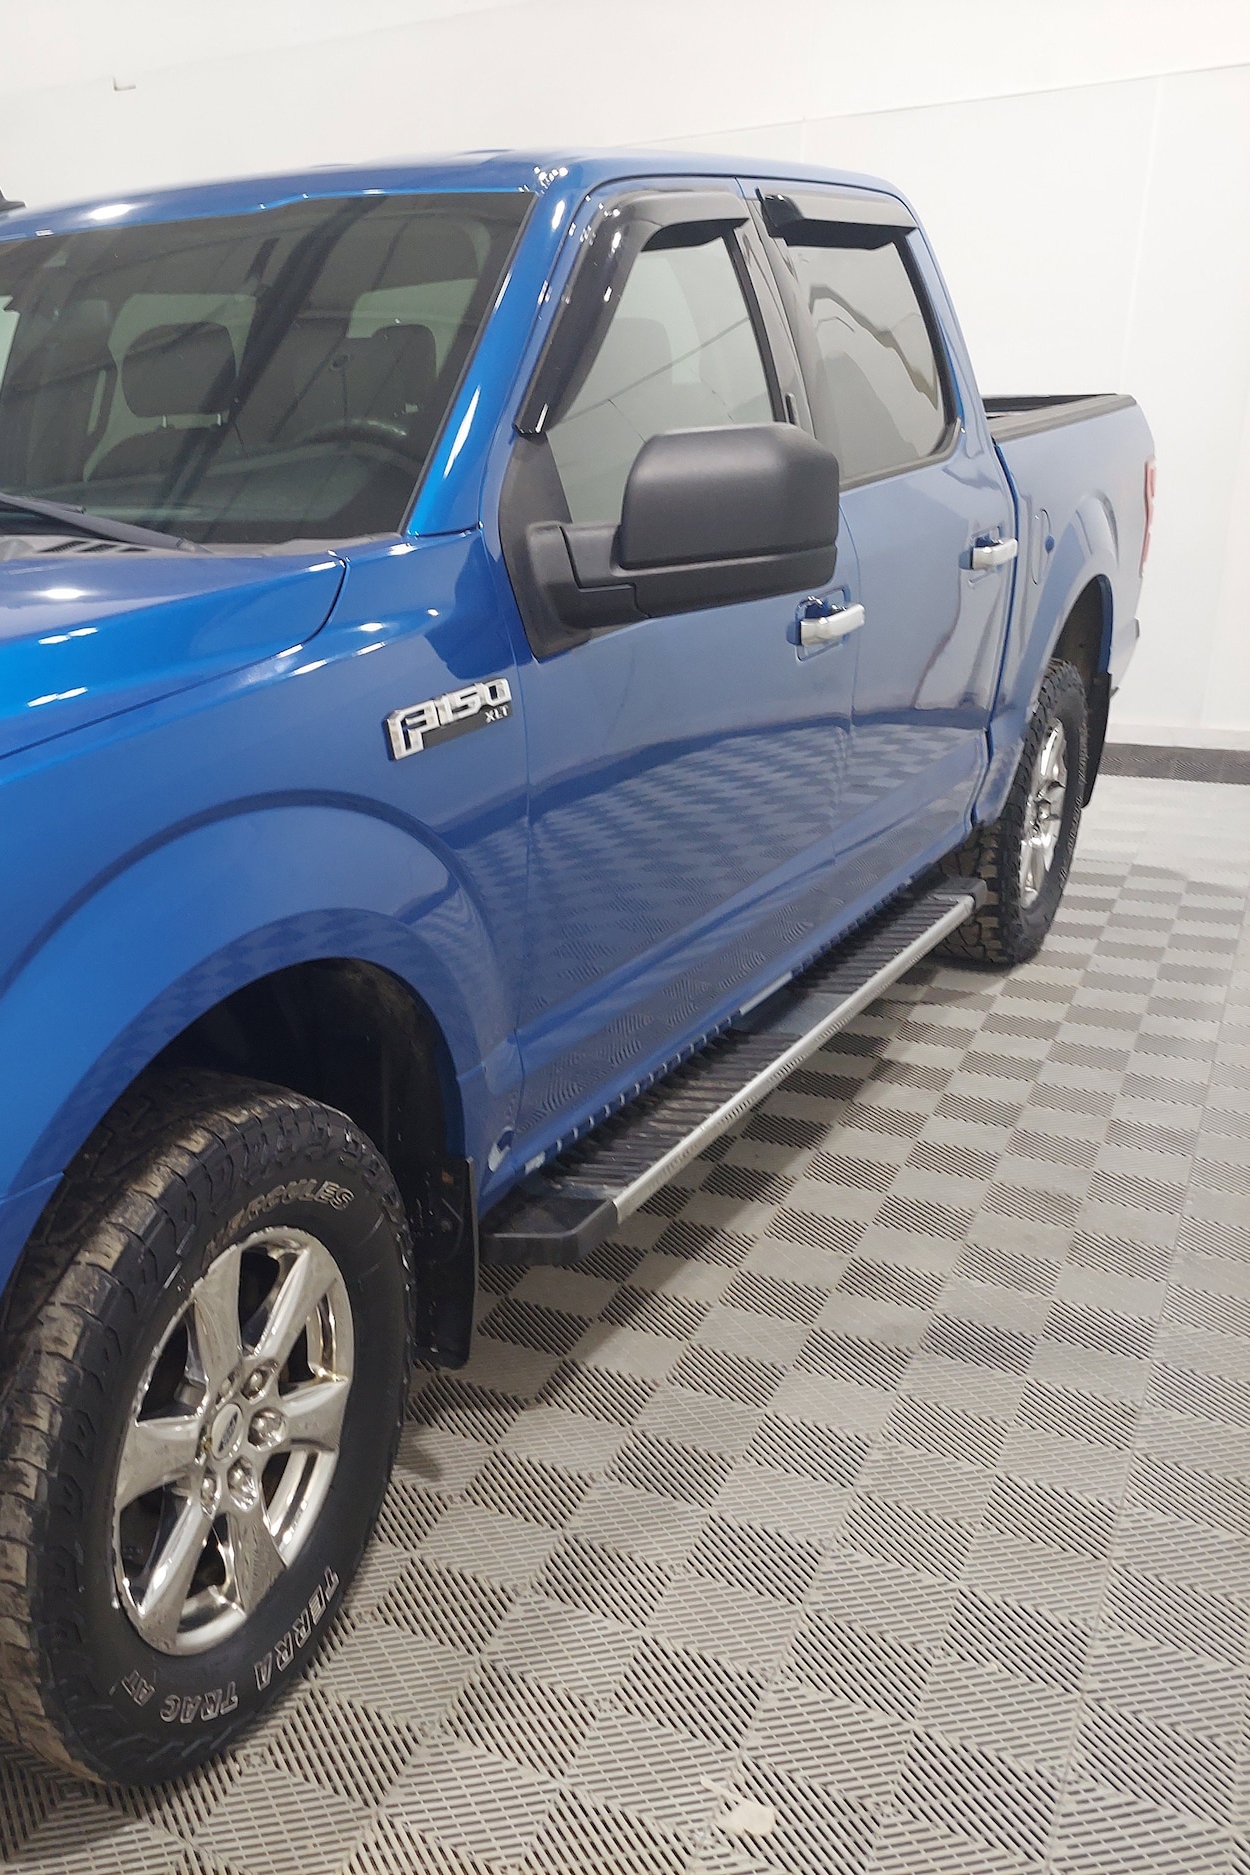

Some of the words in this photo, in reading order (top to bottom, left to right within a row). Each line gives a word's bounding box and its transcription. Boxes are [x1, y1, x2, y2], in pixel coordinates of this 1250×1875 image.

[484, 704, 509, 724] XLT
[253, 1565, 341, 1691] TERRA
[160, 1682, 239, 1724] TRAC
